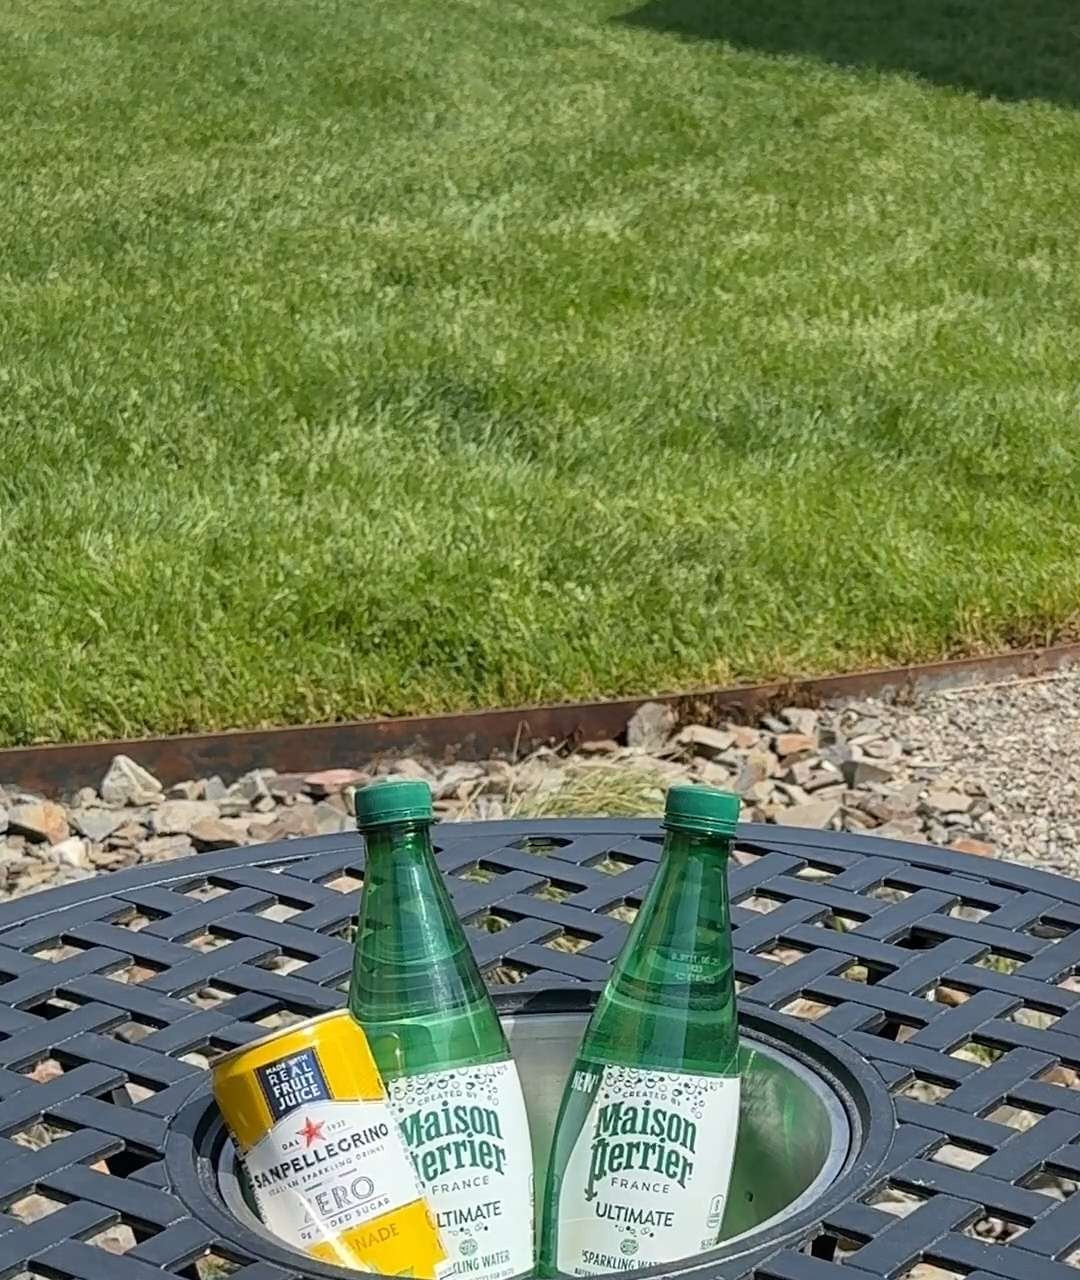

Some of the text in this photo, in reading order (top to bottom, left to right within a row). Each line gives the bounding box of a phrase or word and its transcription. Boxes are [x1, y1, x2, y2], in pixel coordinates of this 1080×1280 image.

[268, 1062, 312, 1085] REAL
[273, 1072, 315, 1098] FRUIT
[279, 1083, 321, 1111] JUICE
[417, 1090, 462, 1107] CREATED
[623, 1091, 667, 1101] CREATED
[399, 1100, 504, 1148] Maison
[593, 1099, 697, 1154] Maison
[254, 1123, 389, 1189] SANPELLEGRINO
[281, 1140, 300, 1150] DAL
[301, 1159, 353, 1184] SPARKLING
[431, 1175, 489, 1195] FRANCE
[610, 1177, 671, 1194] FRANCE
[355, 1197, 391, 1217] SUGAR
[436, 1200, 502, 1228] LTIMATE
[595, 1201, 675, 1228] ULTIMATE
[481, 1249, 511, 1268] WATER
